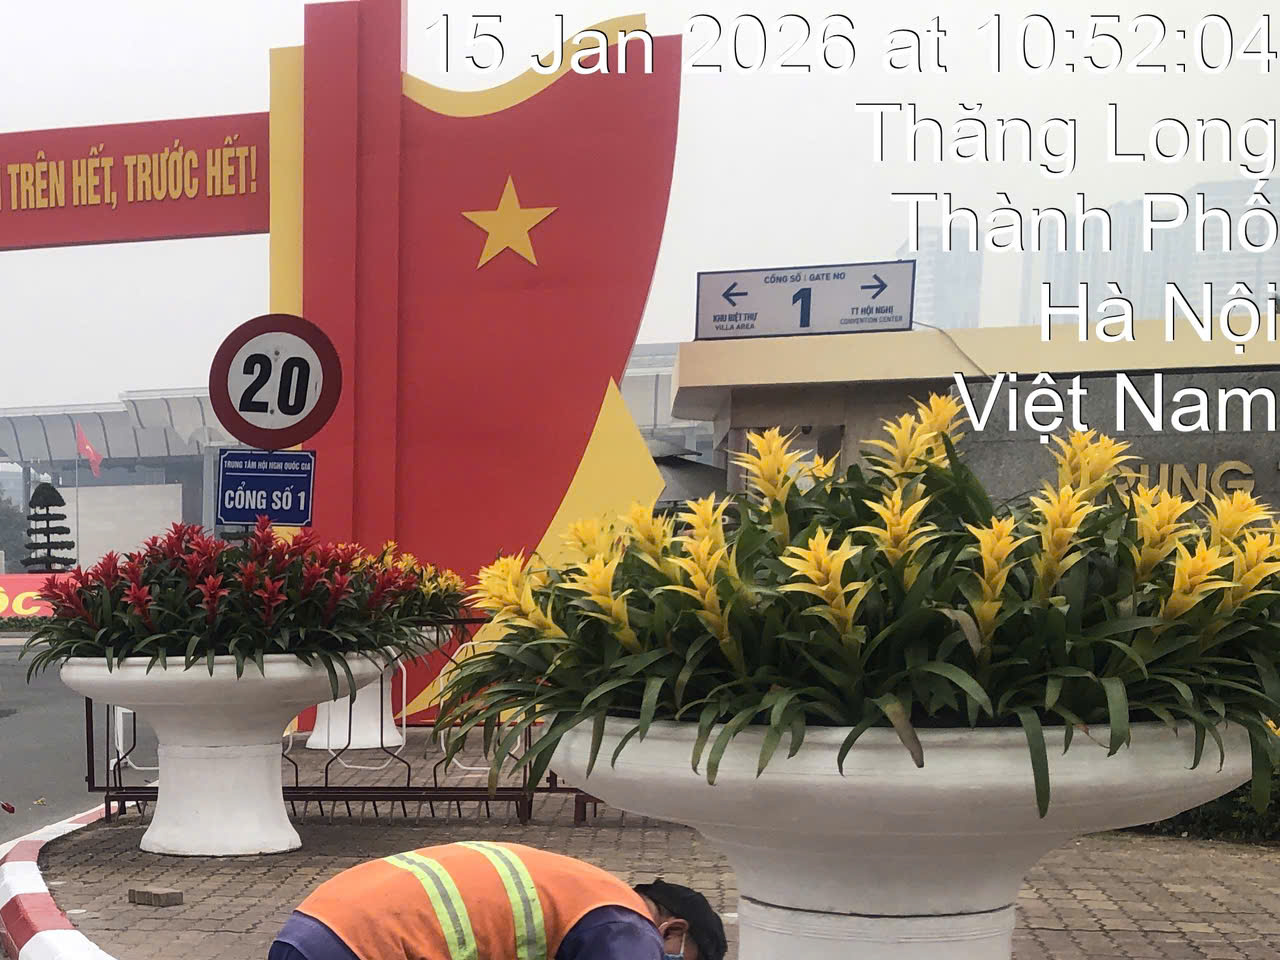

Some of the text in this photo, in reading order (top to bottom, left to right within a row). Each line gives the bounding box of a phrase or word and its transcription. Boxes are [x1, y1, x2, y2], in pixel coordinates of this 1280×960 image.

[7, 149, 66, 211] TRÊN
[72, 142, 118, 210] HẾT,
[124, 138, 200, 204] TRƯỚC
[206, 133, 258, 198] HẾT!
[808, 272, 831, 281] GATE
[832, 271, 846, 280] NO
[792, 287, 812, 328] 1
[238, 352, 311, 416] 20
[224, 460, 243, 469] TRUNG
[1089, 460, 1255, 505] RUNG
[224, 480, 306, 511] CỔNG SỐ 1
